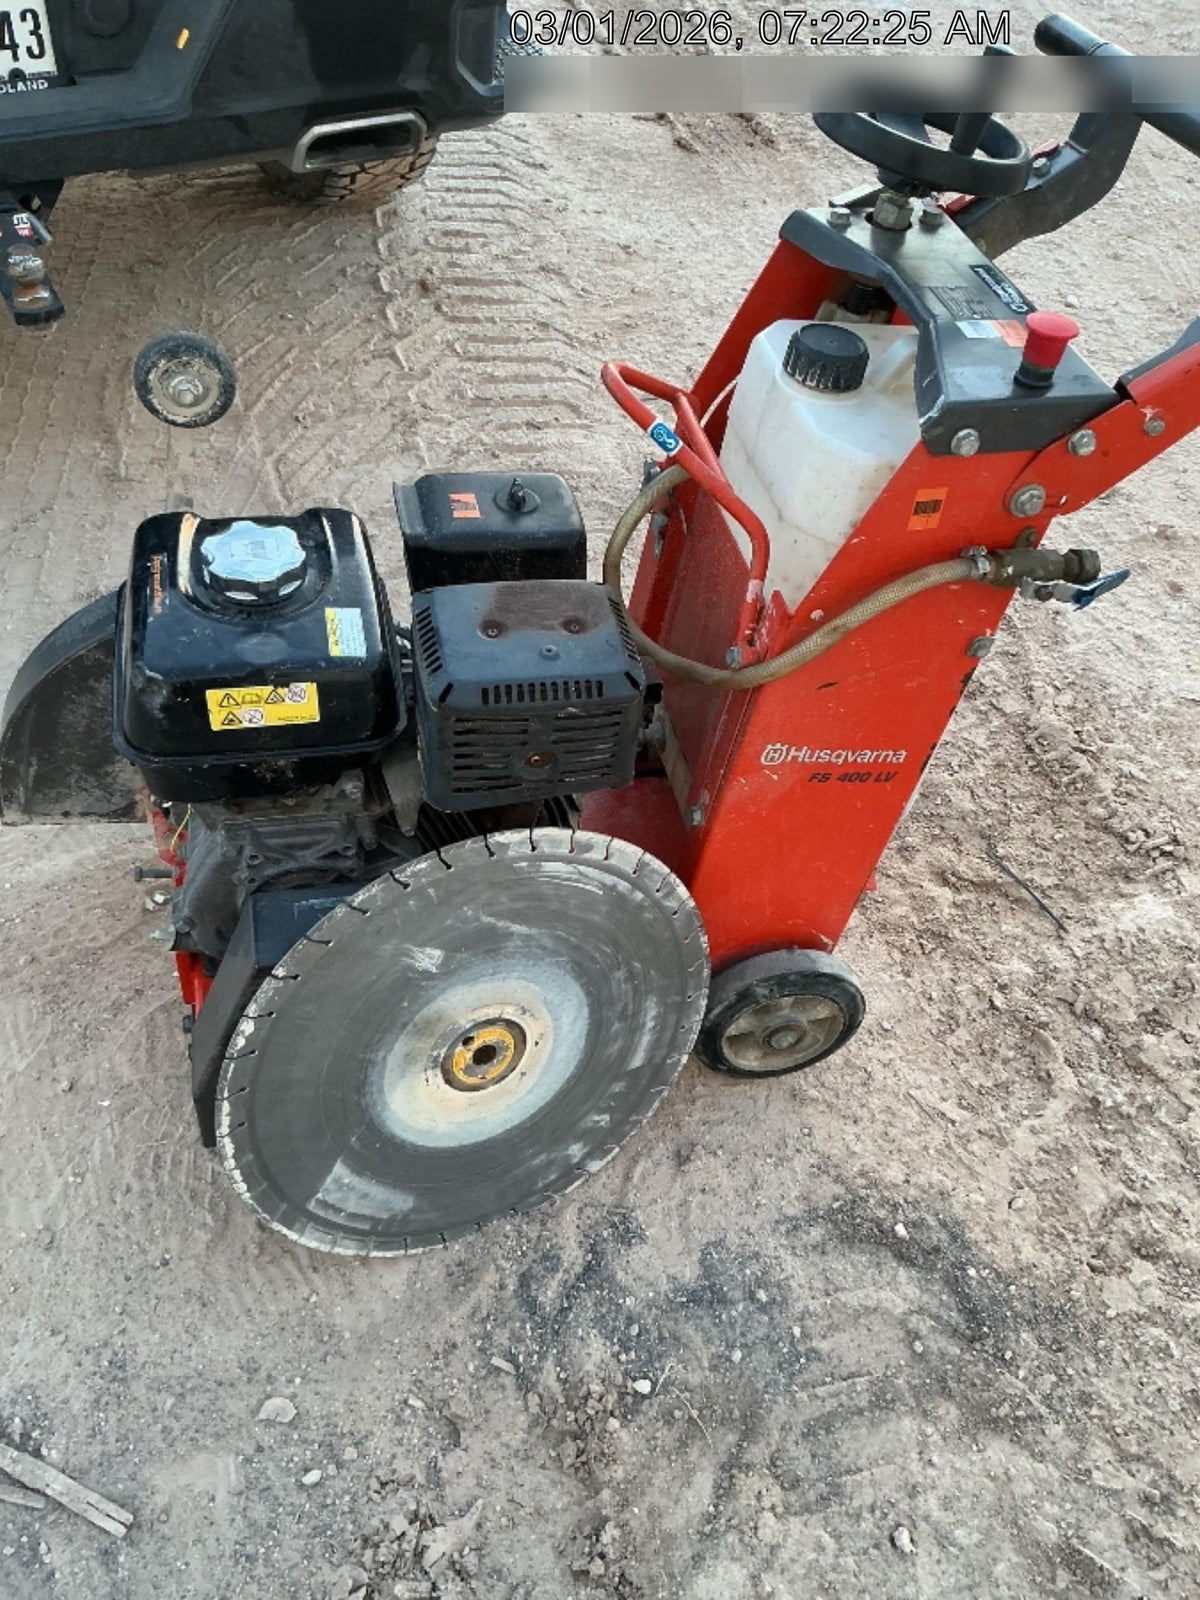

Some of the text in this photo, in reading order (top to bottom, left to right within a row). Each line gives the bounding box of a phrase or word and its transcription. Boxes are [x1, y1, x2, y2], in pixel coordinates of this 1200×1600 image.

[0, 8, 46, 62] 43
[787, 746, 907, 765] Husqvarna
[809, 772, 897, 783] FS 400 LV
